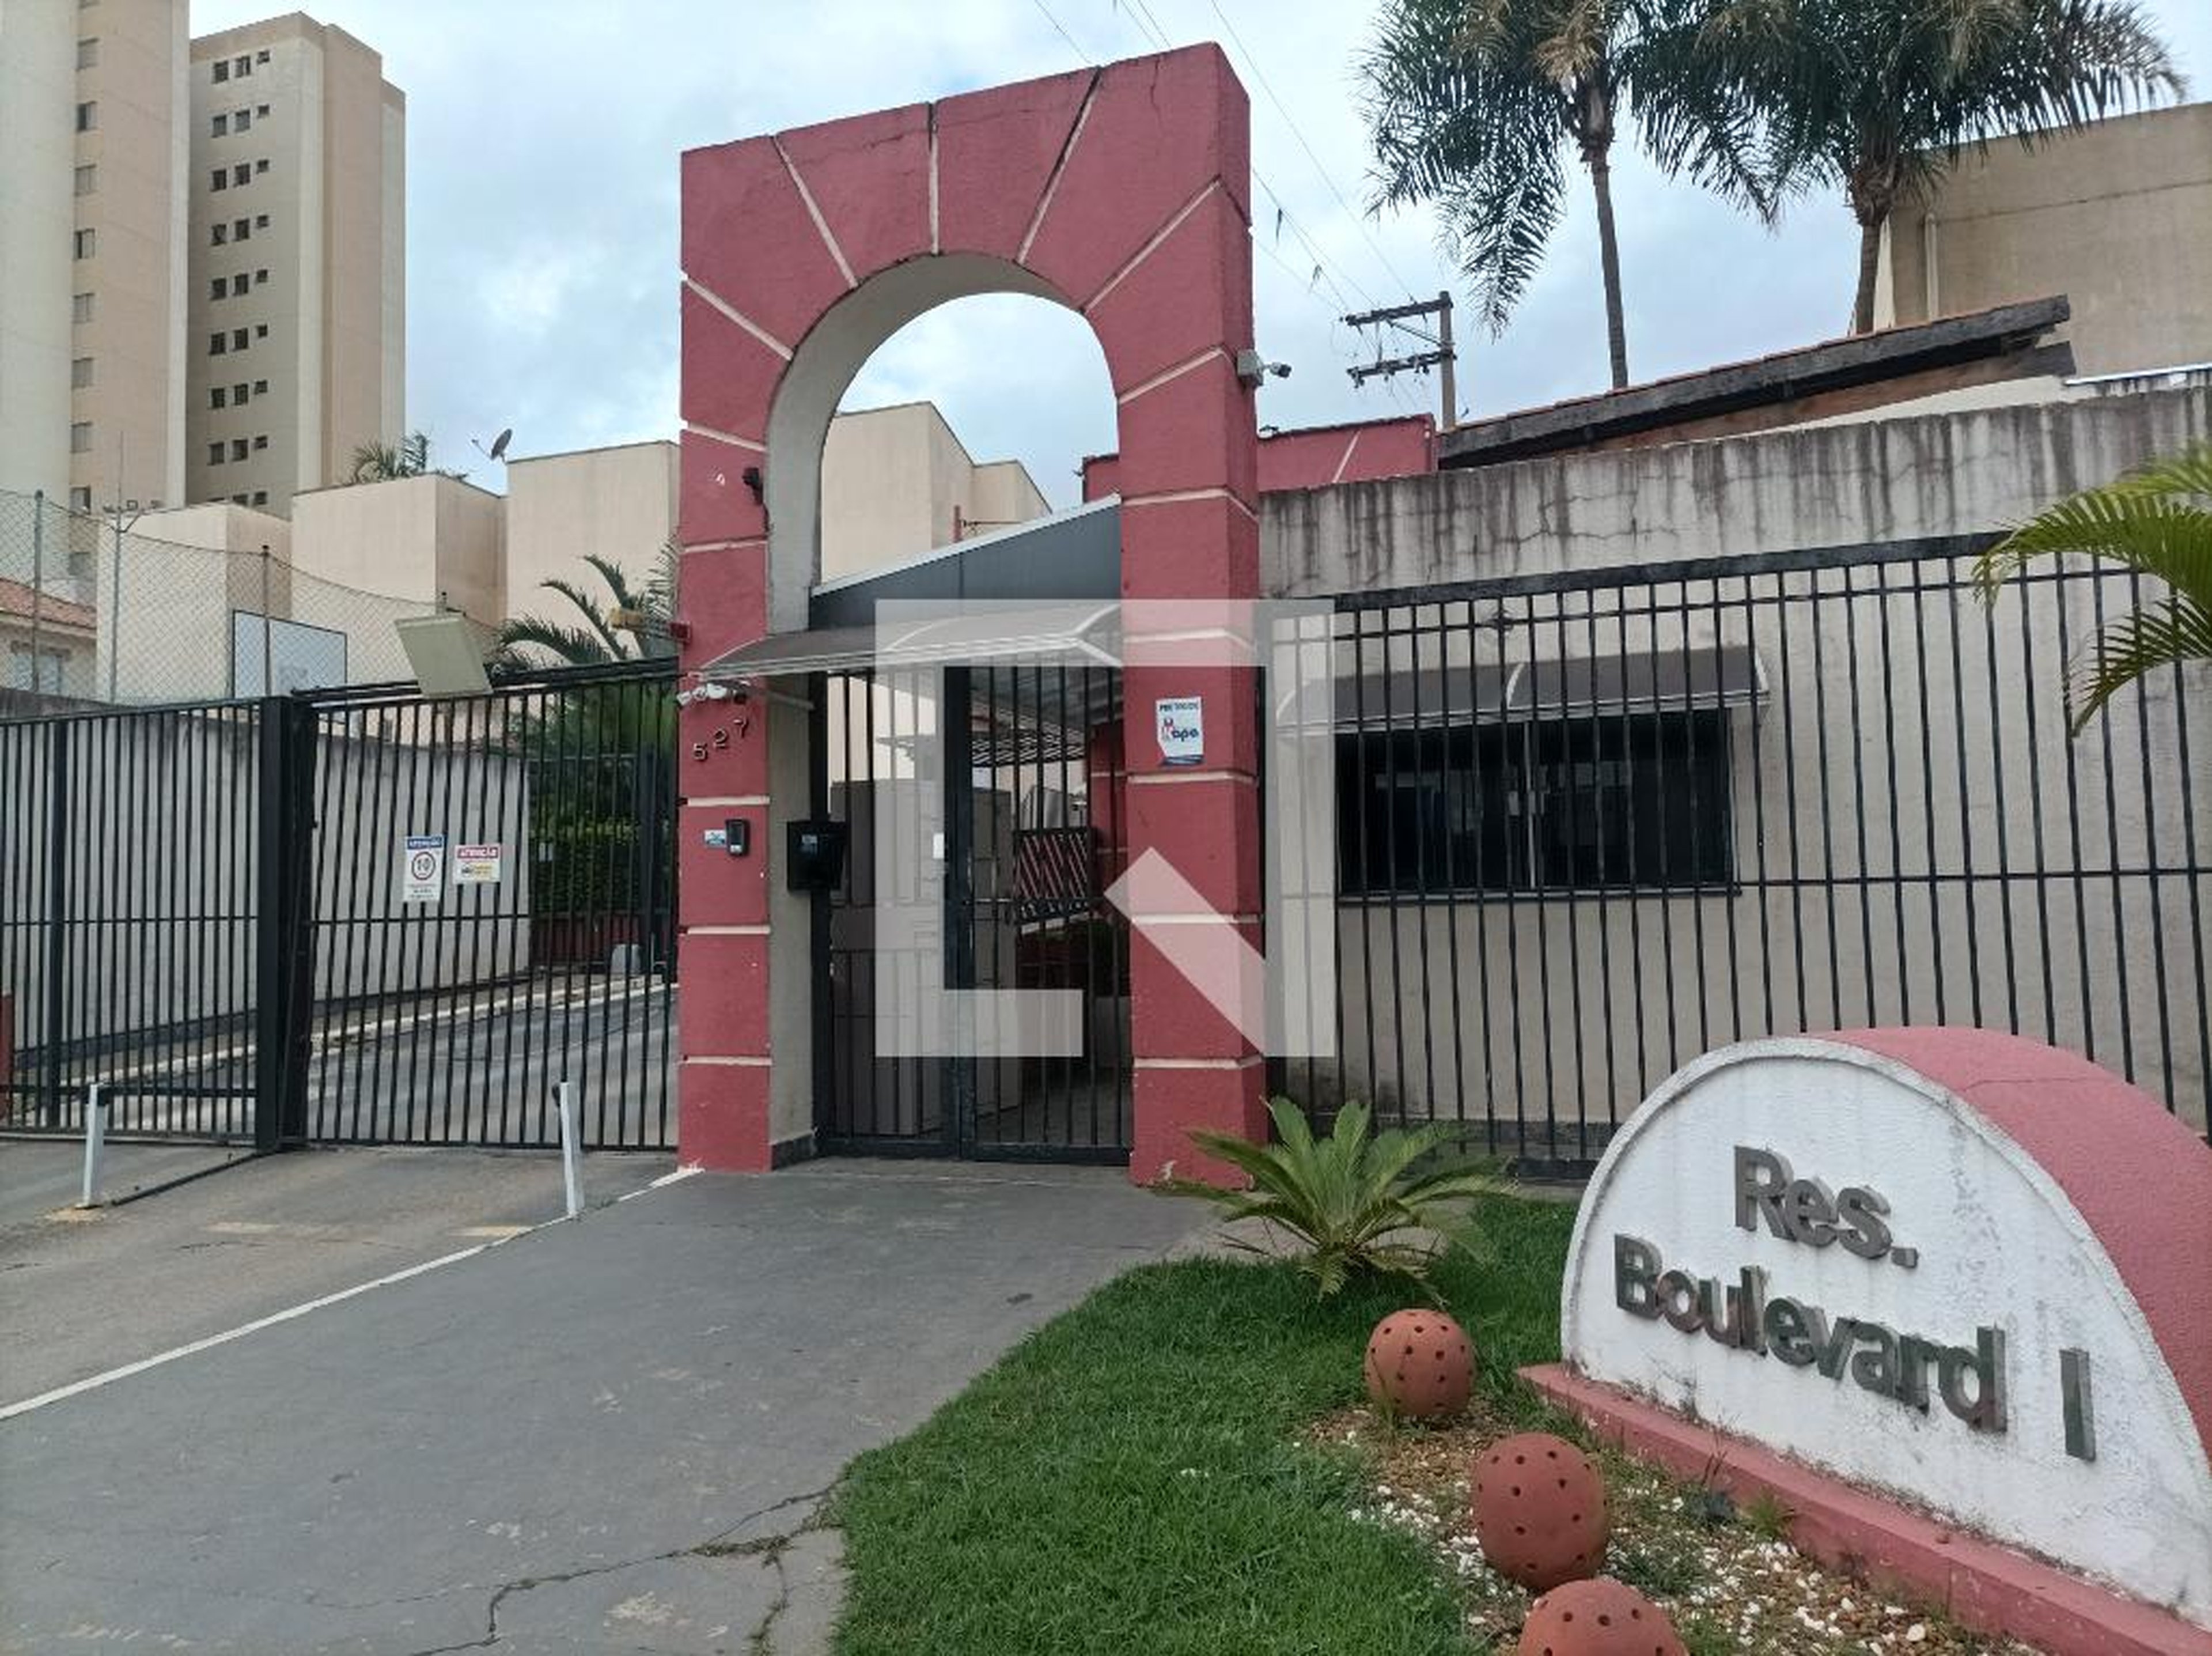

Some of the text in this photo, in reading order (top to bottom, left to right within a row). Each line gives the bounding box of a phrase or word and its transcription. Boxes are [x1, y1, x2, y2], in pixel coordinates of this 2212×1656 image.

[693, 717, 748, 762] 527
[1734, 1144, 1919, 1269] Res.
[1615, 1234, 2096, 1462] Boulevard I
